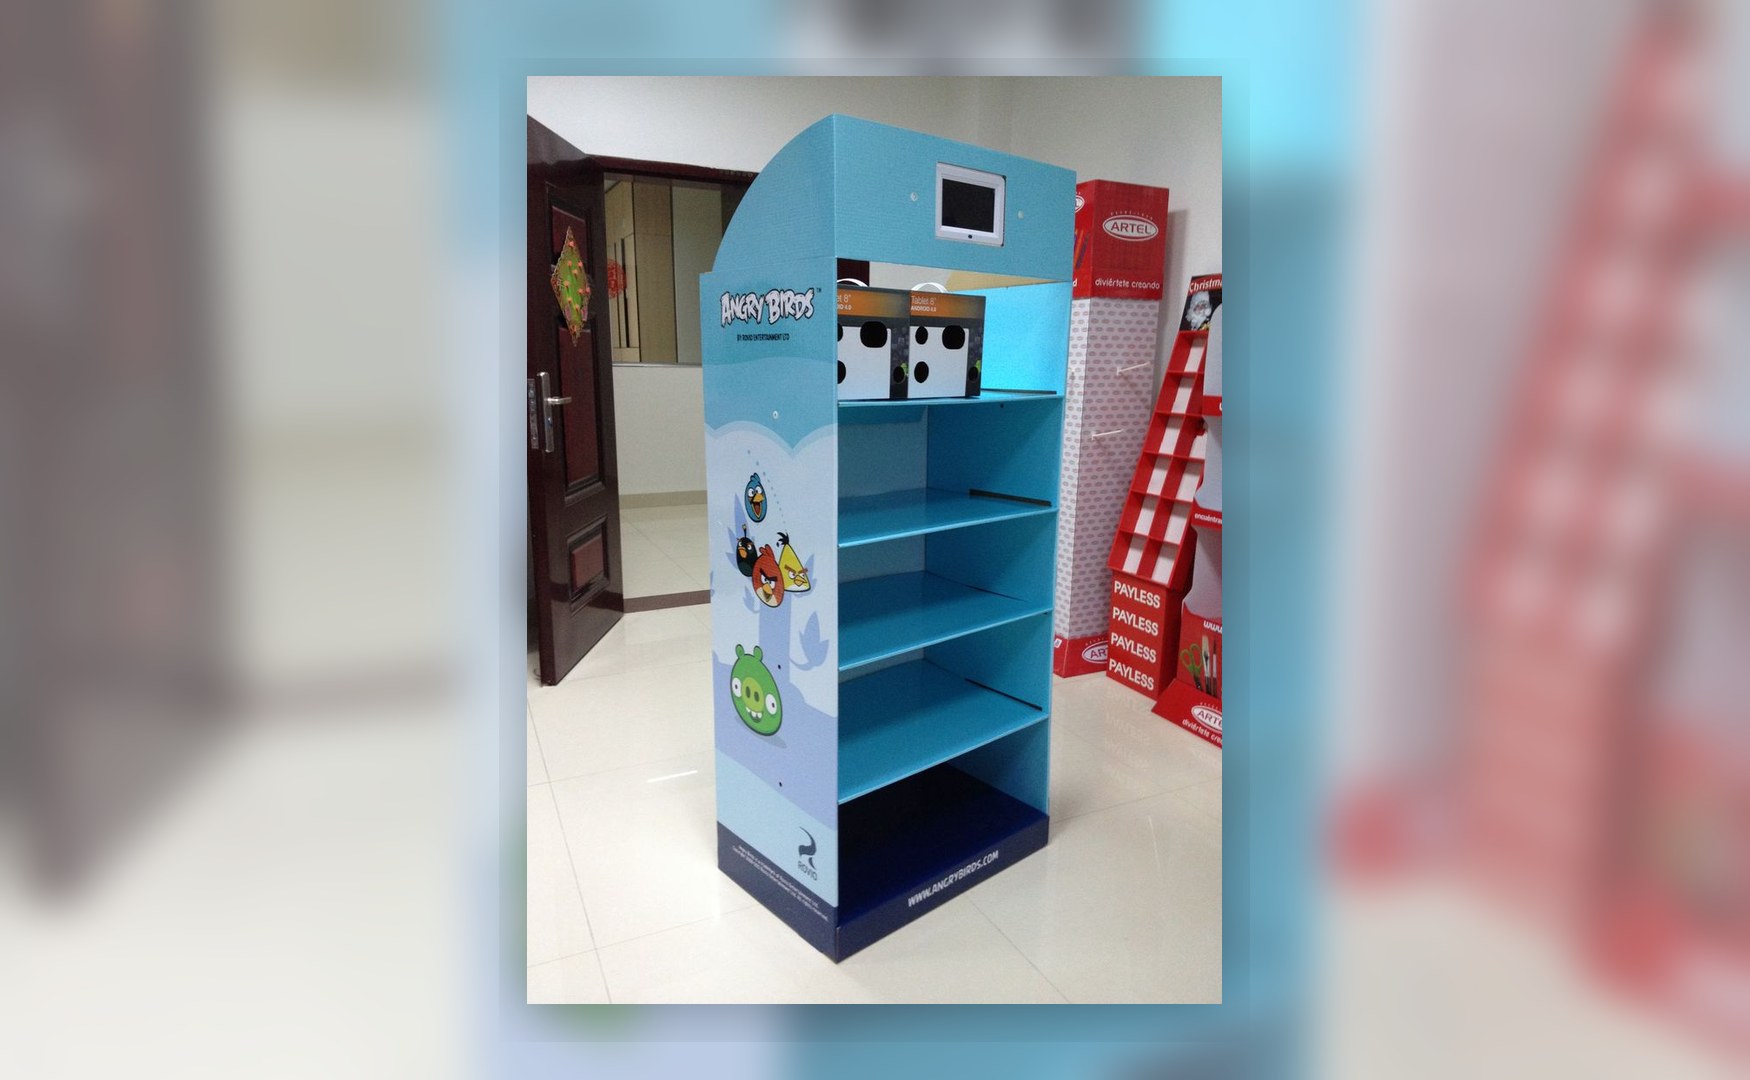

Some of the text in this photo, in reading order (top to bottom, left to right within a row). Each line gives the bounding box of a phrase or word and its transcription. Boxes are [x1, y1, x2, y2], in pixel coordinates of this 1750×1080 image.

[1110, 221, 1152, 235] ARTEL
[1094, 278, 1160, 290] diviértete creando
[1189, 278, 1222, 293] Christm
[721, 291, 764, 328] ANGRY
[765, 287, 815, 325] BIRDS
[753, 332, 782, 341] ENTERTAINMENT
[1114, 580, 1161, 609] PAYLESS
[1112, 606, 1159, 636] PAYLESS
[1110, 632, 1157, 663] PAYLESS
[1108, 658, 1155, 690] PAYLESS
[797, 860, 818, 881] ROVIO
[908, 850, 999, 907] WWW.ANGRYBIRDS.COM
